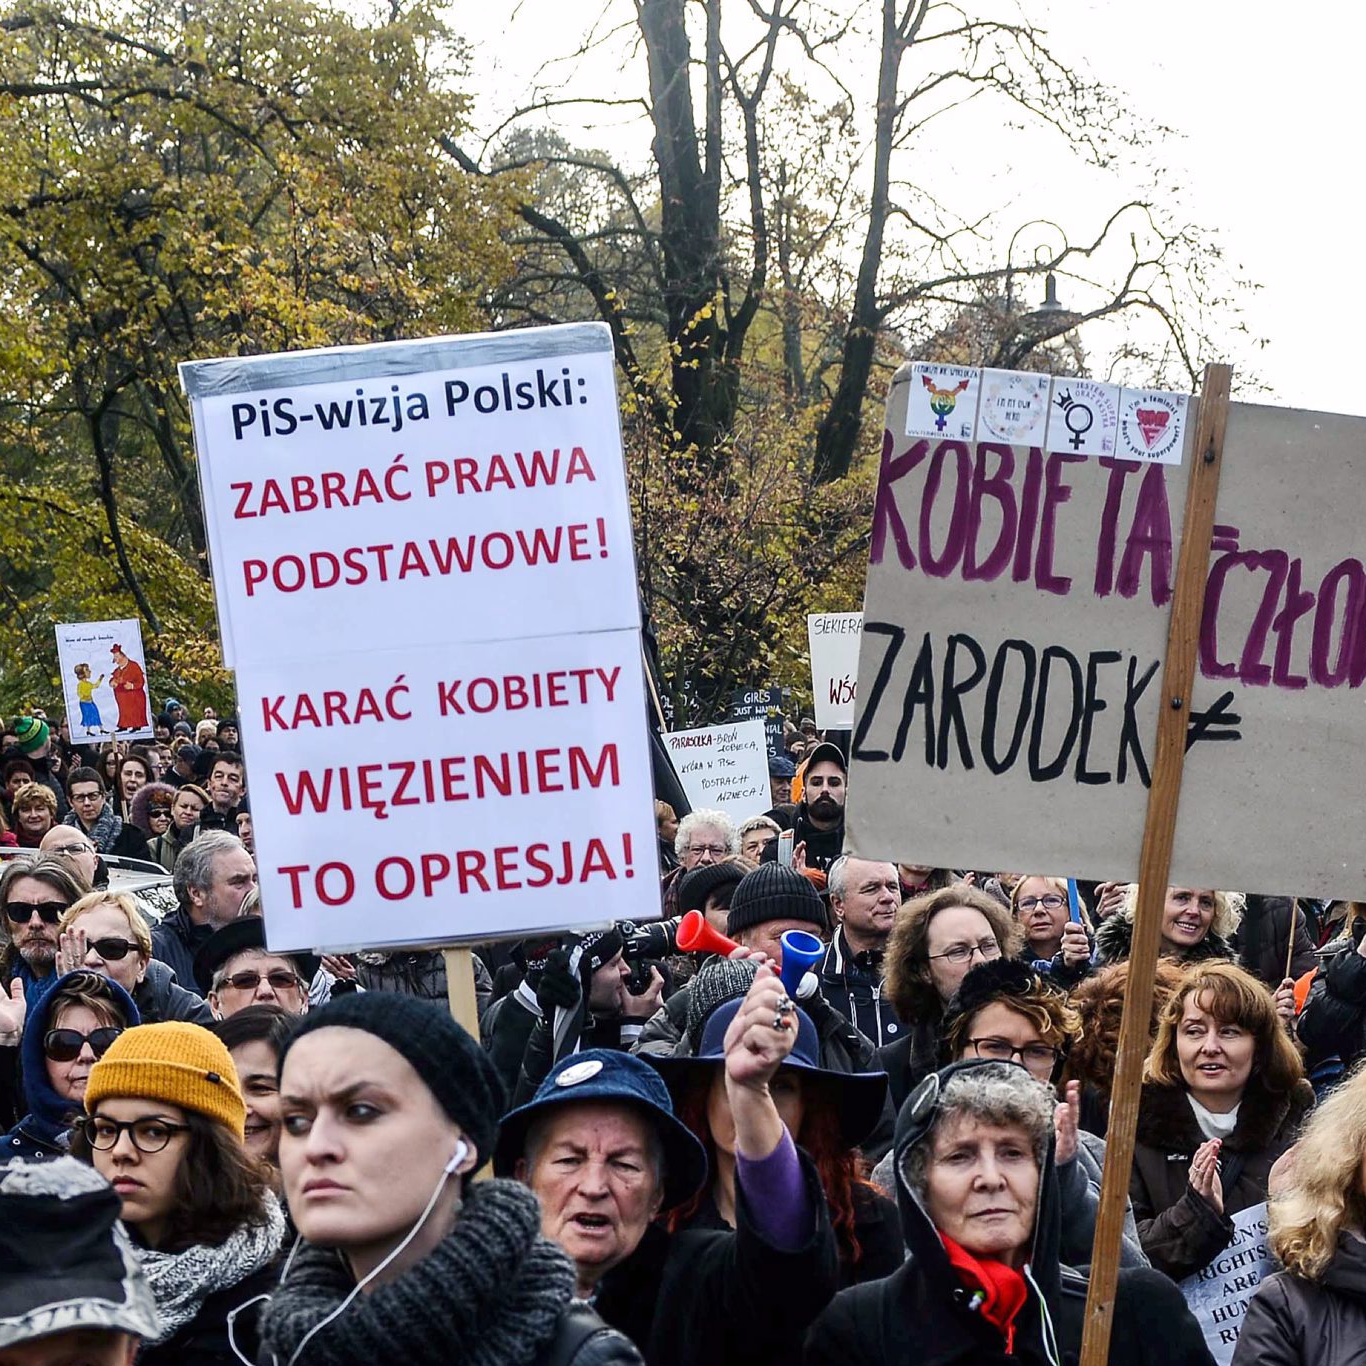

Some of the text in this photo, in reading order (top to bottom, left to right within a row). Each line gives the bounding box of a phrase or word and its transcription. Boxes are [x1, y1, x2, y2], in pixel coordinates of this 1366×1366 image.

[232, 368, 589, 440] PiS-wizja Polski:
[230, 446, 596, 519] ZABRAĆ PRAWA
[869, 429, 1174, 607] KOBIETA
[242, 517, 609, 597] PODSTAWOWE!
[261, 675, 413, 732] KARAĆ
[436, 666, 623, 717] KOBIETY
[734, 705, 752, 716] JUST
[743, 690, 771, 704] GIRLS
[850, 621, 1161, 789] ZARODEK
[275, 743, 621, 819] WIĘZIENIEM
[277, 832, 637, 909] TO OPRESJA!
[1197, 1243, 1268, 1284] RIGHTS
[1226, 1220, 1269, 1250] EN'S
[1222, 1270, 1261, 1298] ARE
